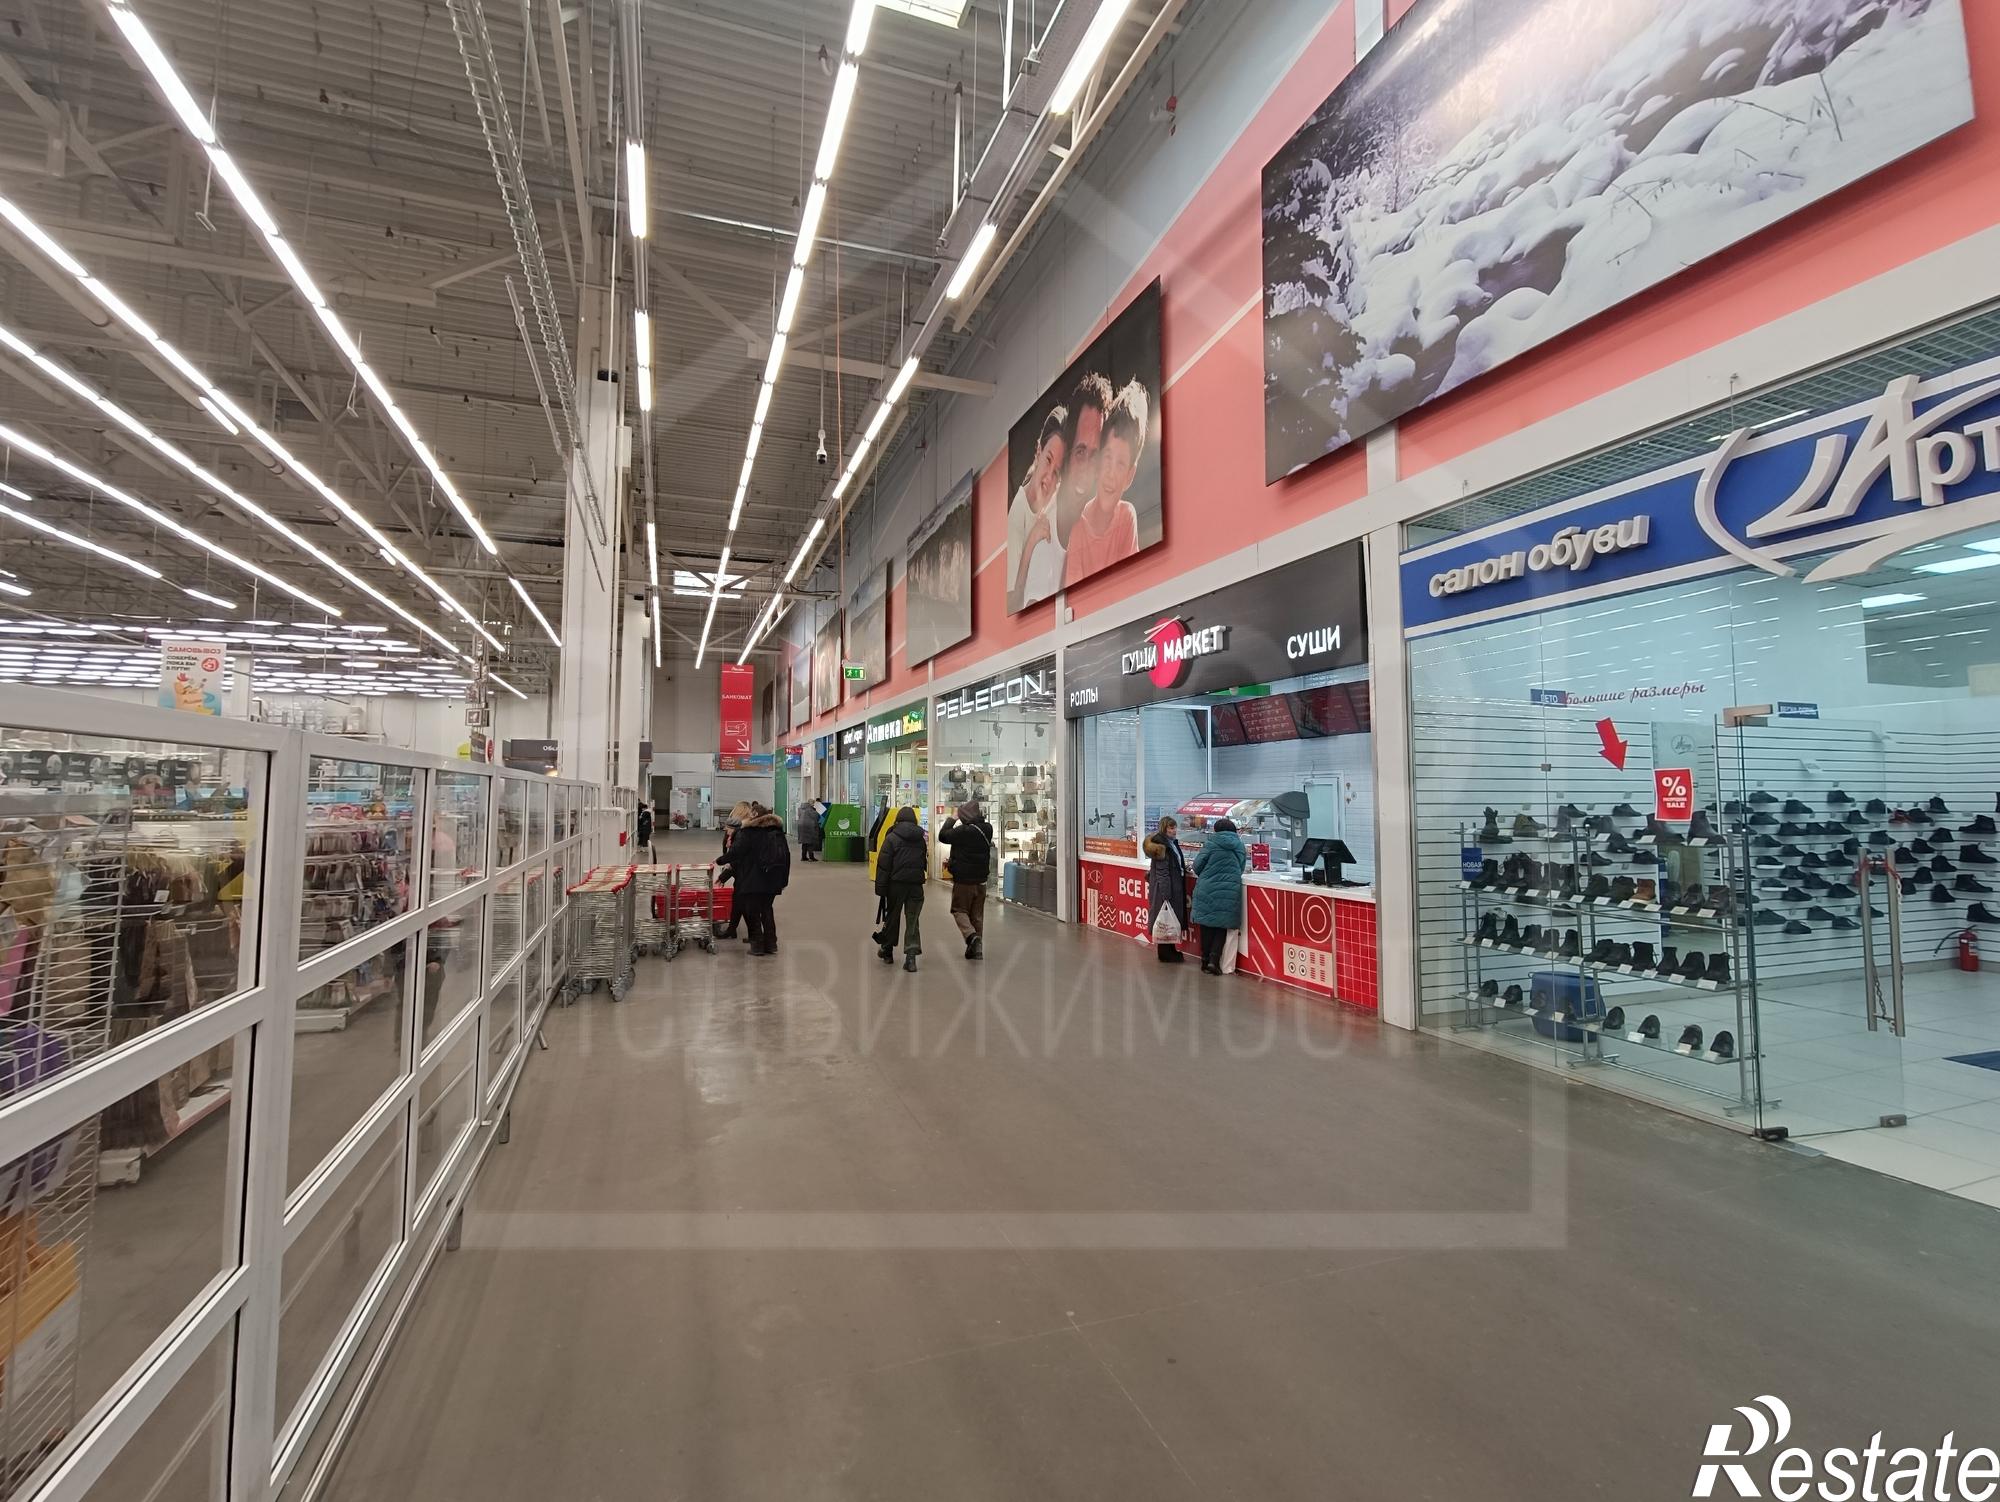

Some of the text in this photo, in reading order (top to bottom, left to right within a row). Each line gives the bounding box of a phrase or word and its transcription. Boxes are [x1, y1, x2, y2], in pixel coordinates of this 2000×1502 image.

[1429, 515, 1649, 598] салон обуви
[1163, 625, 1226, 664] МАРКЕТ
[1286, 624, 1341, 659] СУШИ
[1070, 686, 1099, 708] РОЛЛЫ
[1630, 682, 1707, 703] размеры
[866, 719, 901, 744] Аптека
[1661, 775, 1687, 797] %
[1666, 801, 1686, 809] SALE
[1118, 876, 1142, 899] ВСЕ
